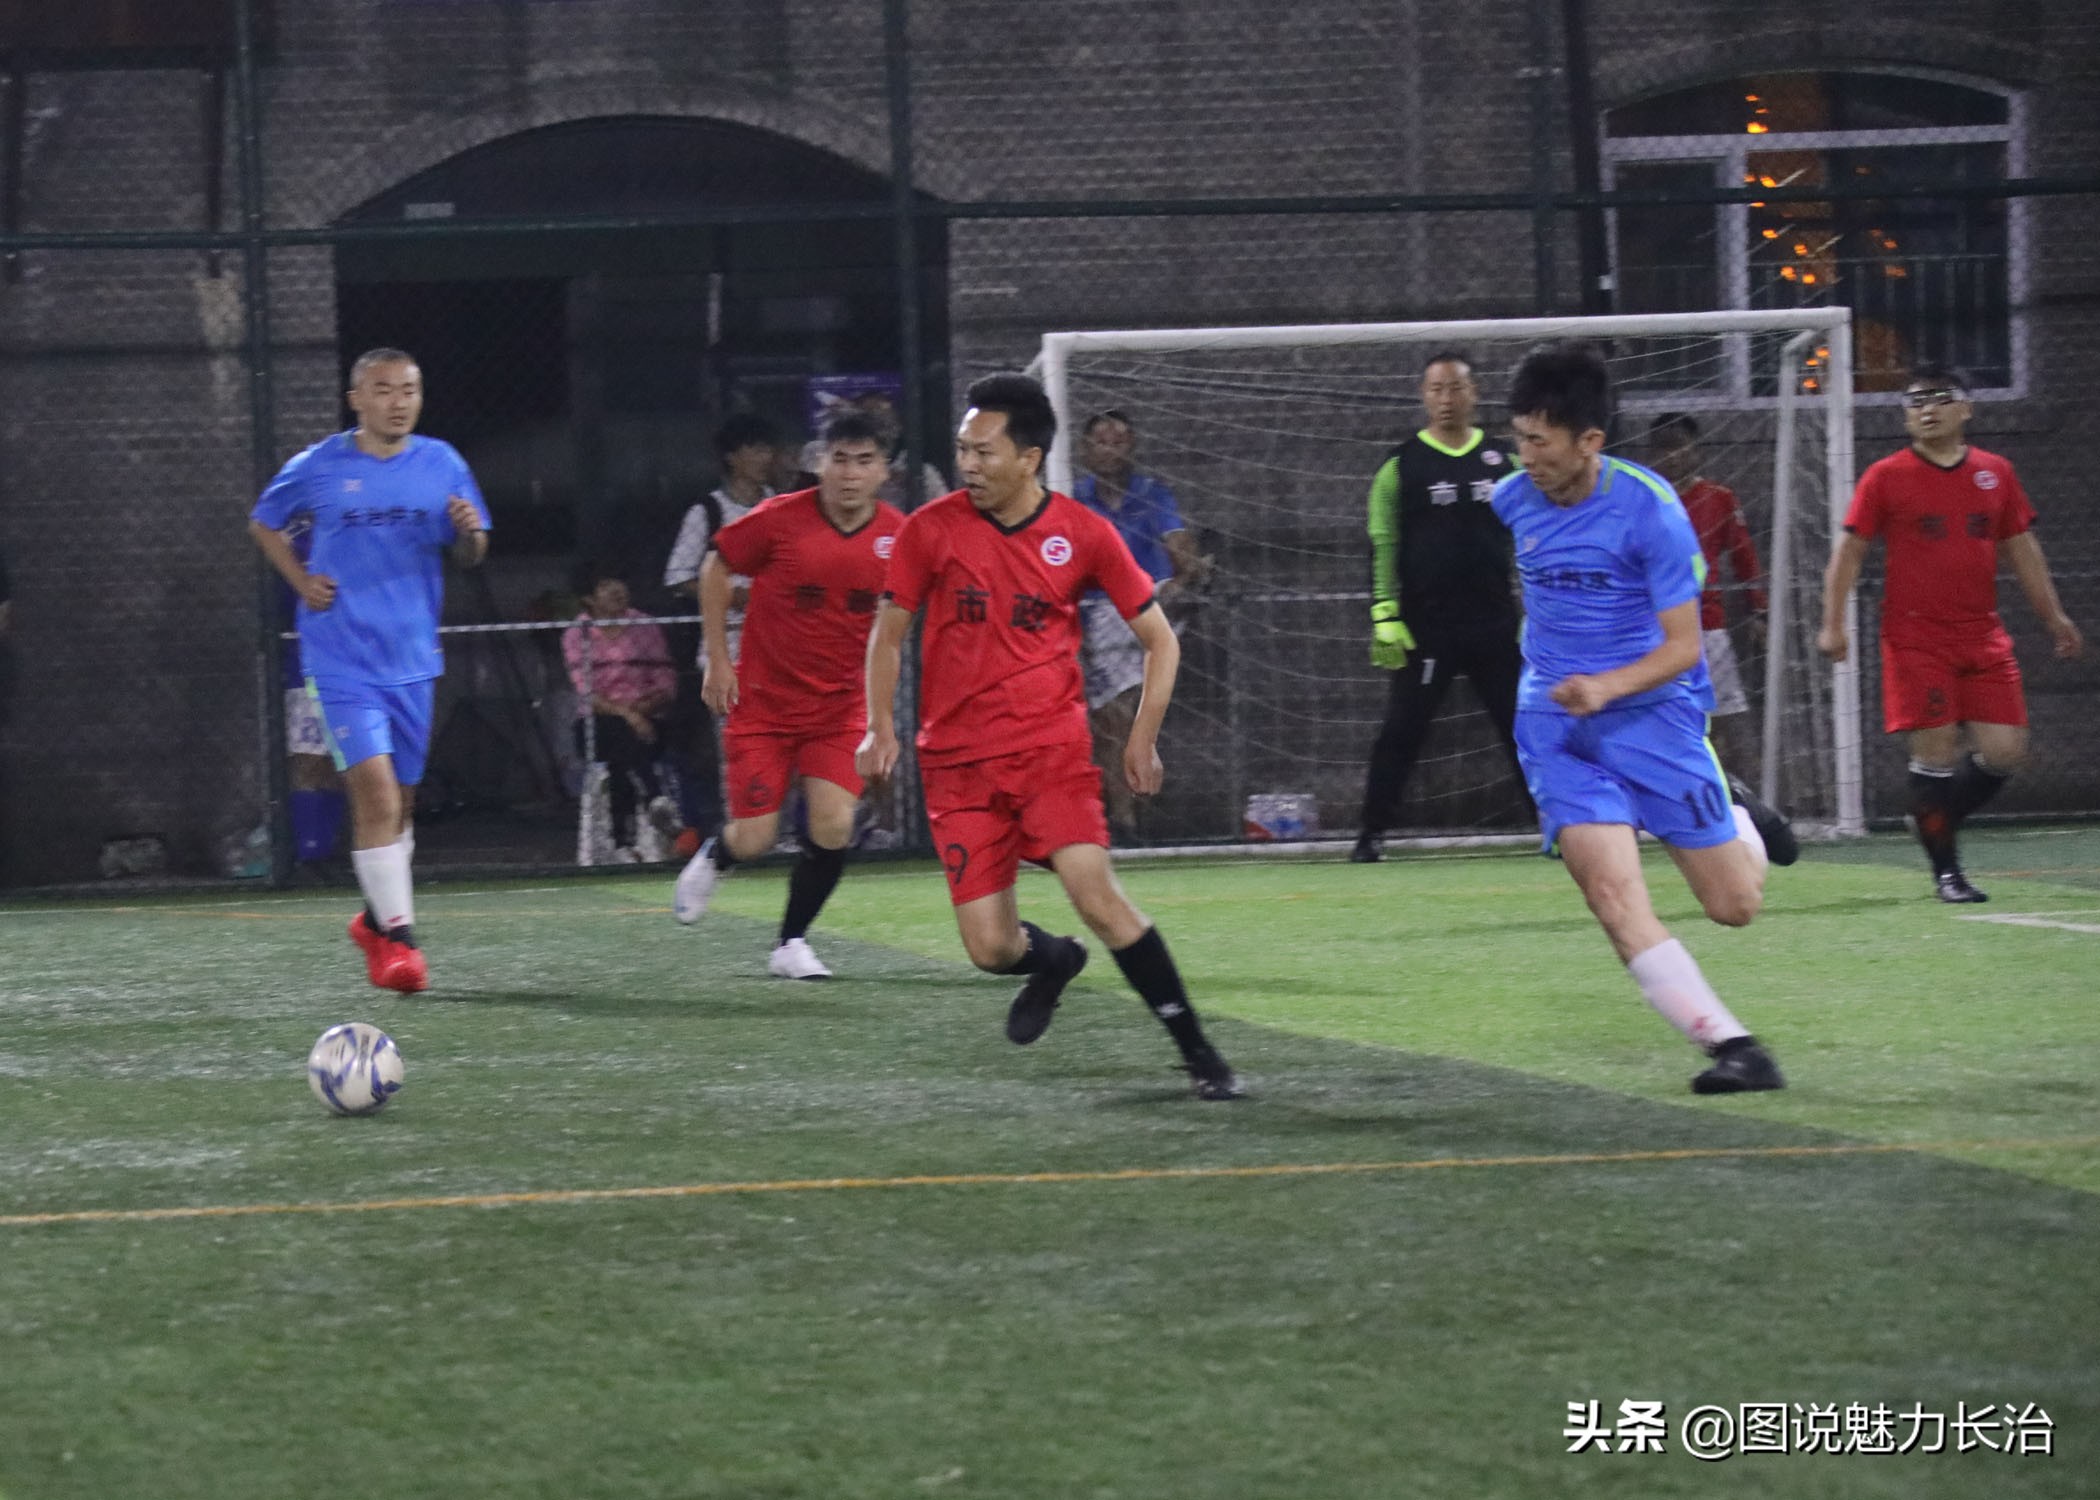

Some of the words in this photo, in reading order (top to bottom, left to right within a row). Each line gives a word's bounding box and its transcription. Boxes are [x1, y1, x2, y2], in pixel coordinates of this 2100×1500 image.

[955, 584, 1052, 632] 市政
[1683, 782, 1726, 830] 10
[945, 842, 969, 885] 9
